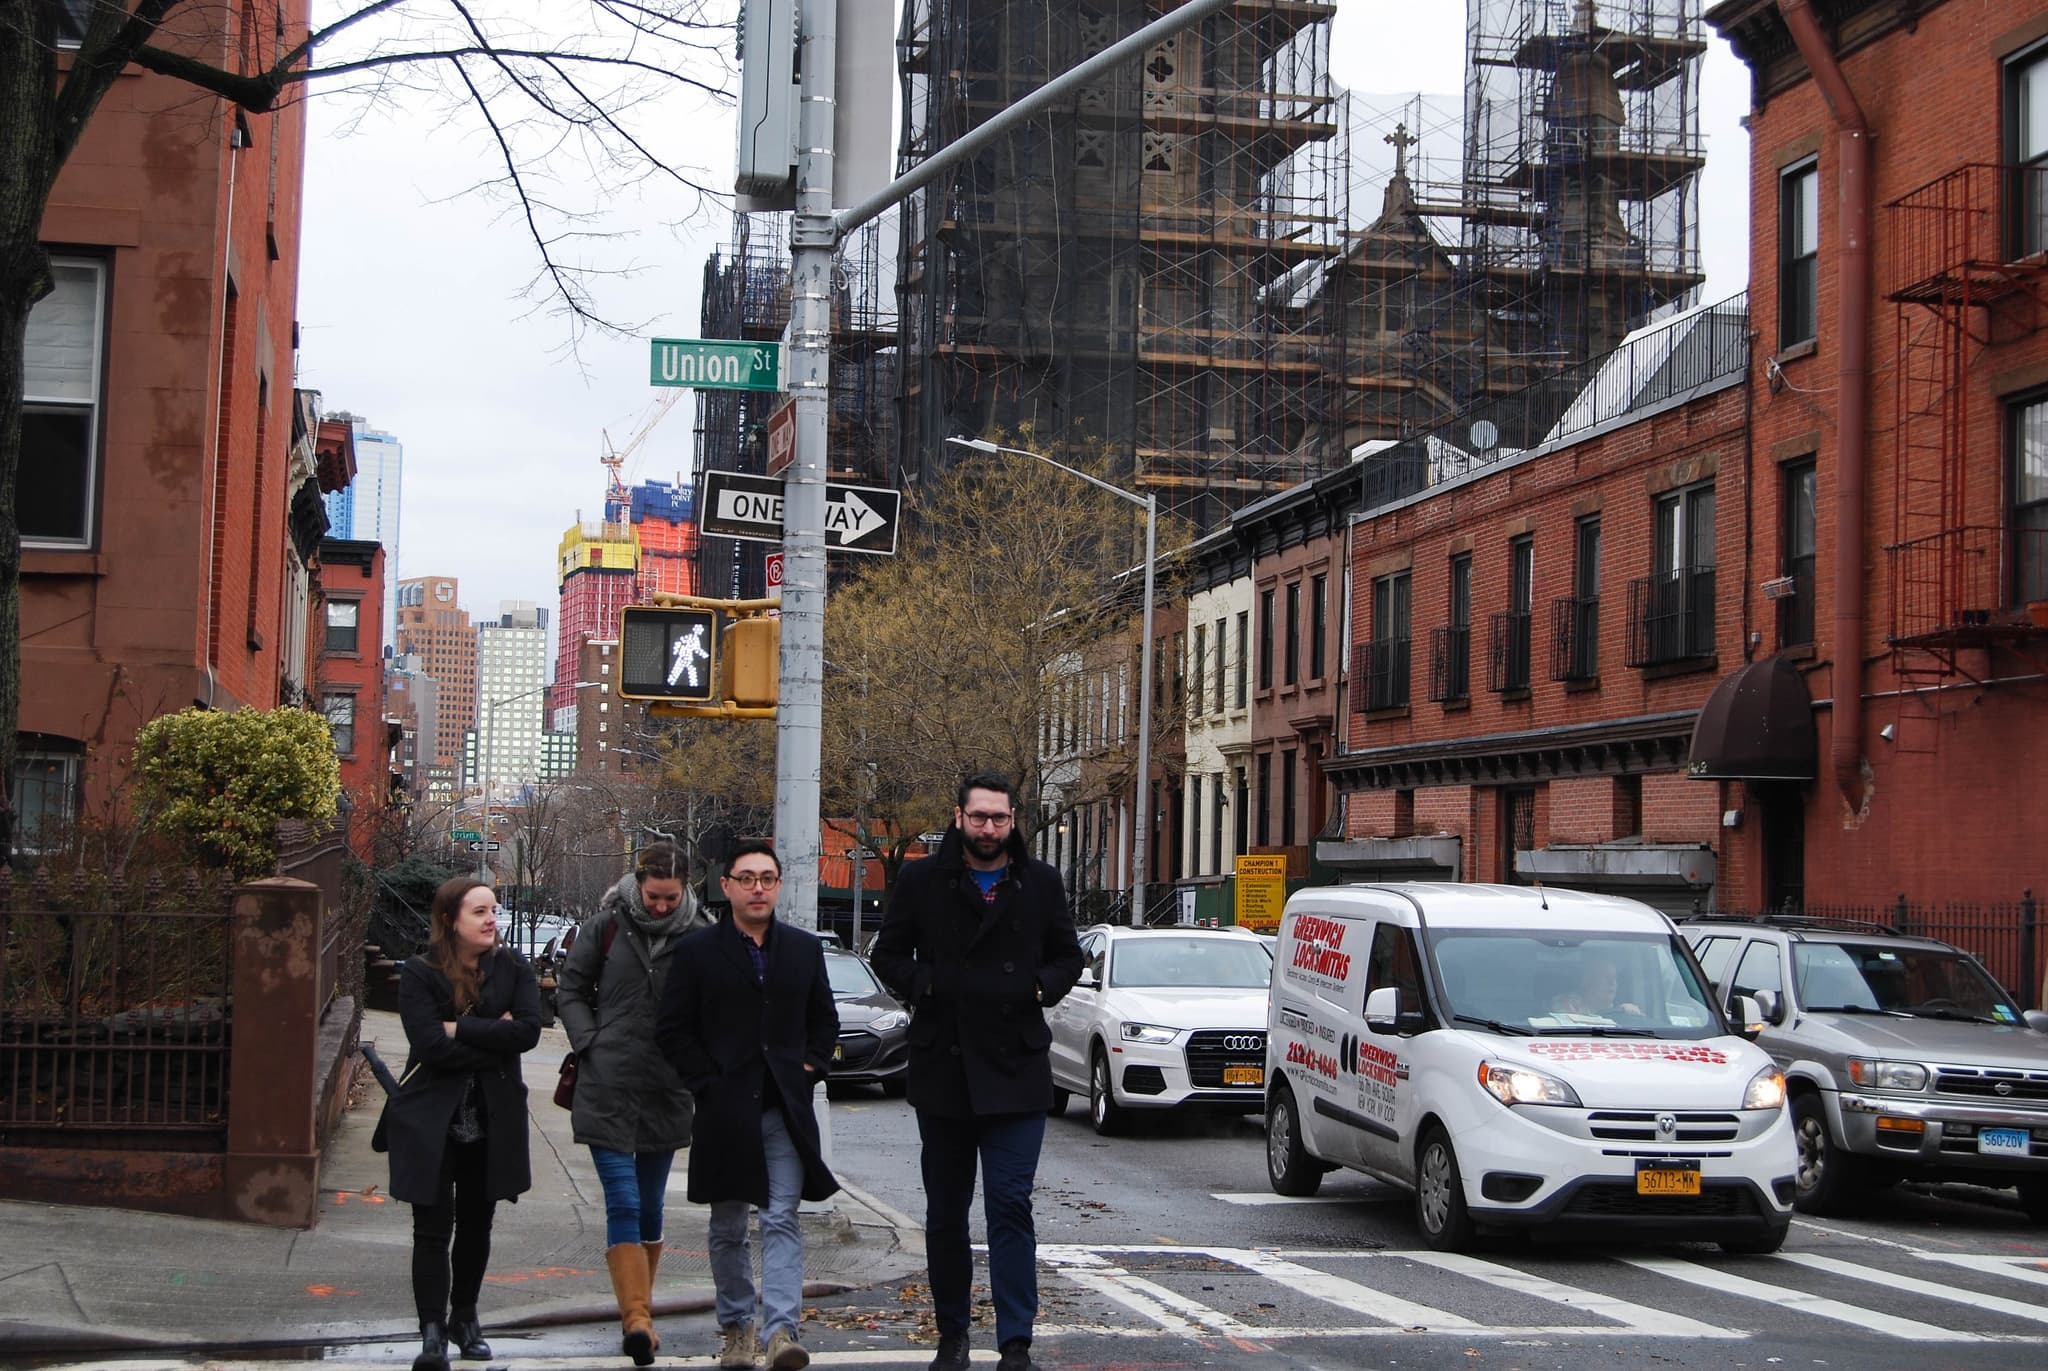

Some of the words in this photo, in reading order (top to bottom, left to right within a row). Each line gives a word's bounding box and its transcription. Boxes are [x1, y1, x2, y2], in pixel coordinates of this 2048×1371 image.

[662, 345, 739, 383] Union
[753, 348, 772, 371] St
[733, 494, 784, 521] ONE
[825, 504, 868, 530] AY
[1293, 914, 1346, 950] GREENWICH
[1293, 941, 1351, 981] LOCKSMITHS
[1360, 1041, 1397, 1070] GREENWICH
[1529, 1047, 1727, 1058] LOCKSMITHS
[1358, 1057, 1397, 1088] LOCKSMITHS
